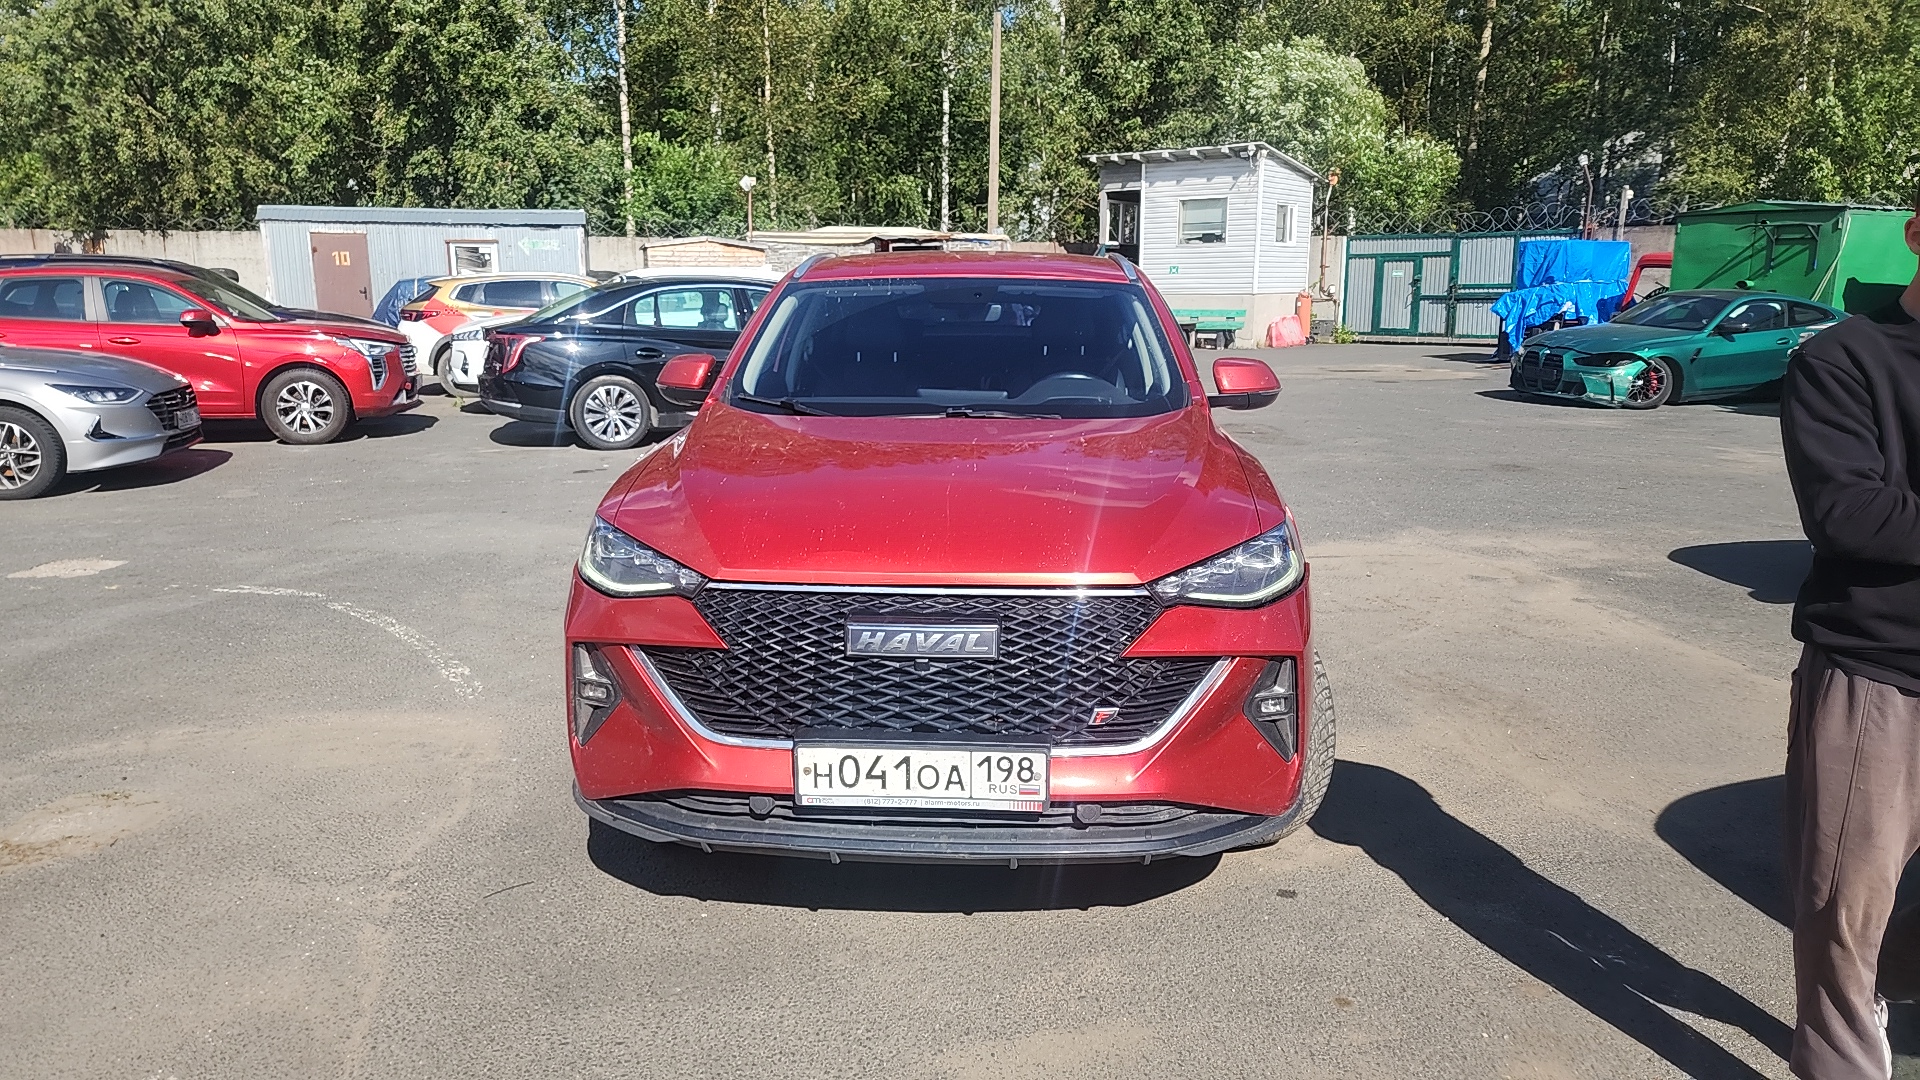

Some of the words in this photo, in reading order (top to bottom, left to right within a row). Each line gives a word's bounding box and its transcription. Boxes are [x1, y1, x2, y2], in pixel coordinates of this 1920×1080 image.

[331, 251, 351, 266] 10
[855, 631, 989, 653] HAVAL
[813, 755, 966, 791] Н041ОА
[977, 755, 1034, 783] 198
[988, 783, 1018, 795] RUS
